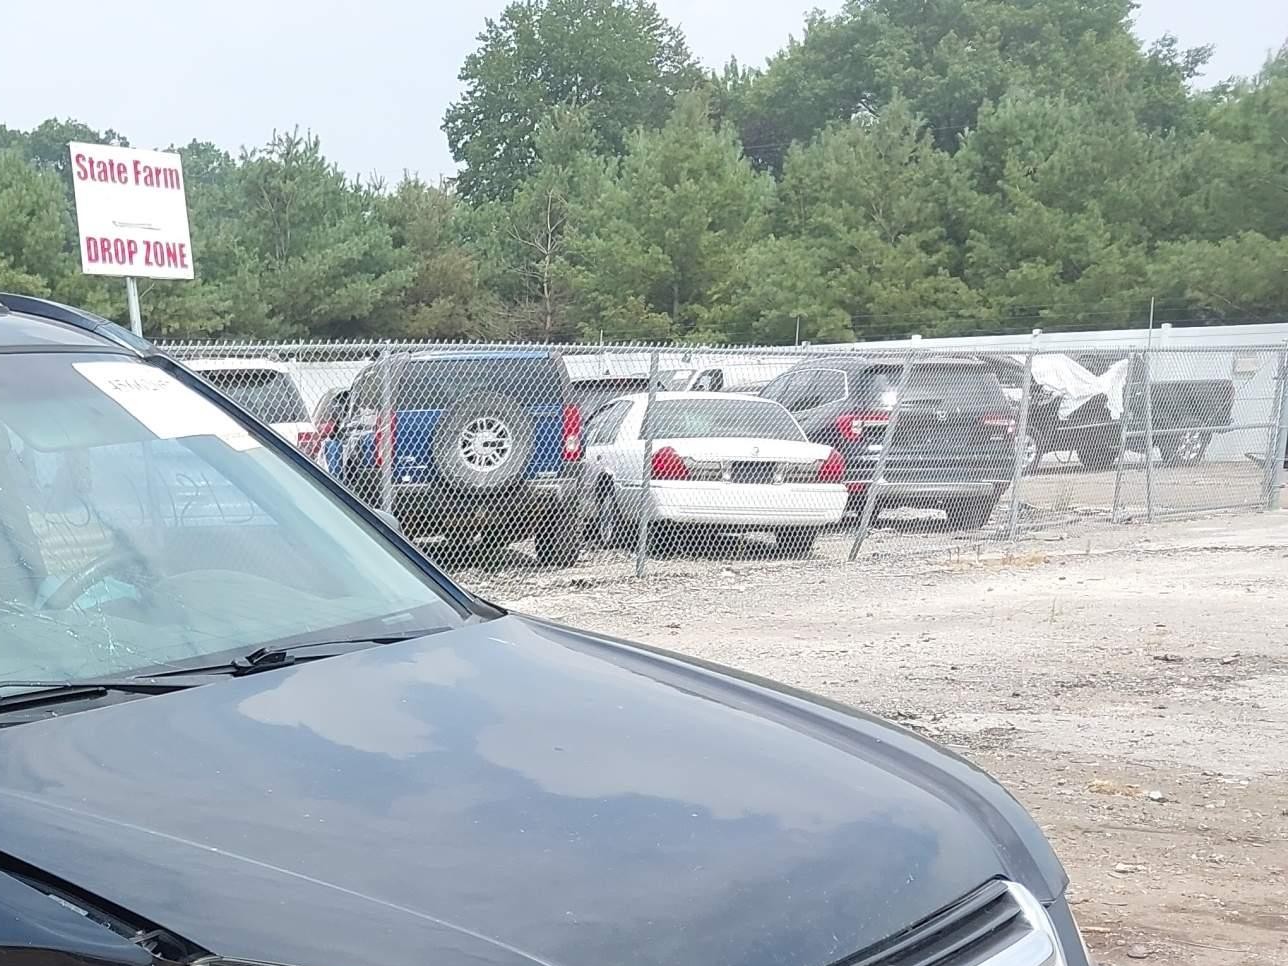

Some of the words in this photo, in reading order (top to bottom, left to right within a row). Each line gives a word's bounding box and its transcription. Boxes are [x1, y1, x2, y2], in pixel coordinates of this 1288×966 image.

[75, 153, 128, 184] State
[133, 159, 181, 190] Farm
[86, 236, 138, 265] DROP
[143, 240, 189, 269] ZONE
